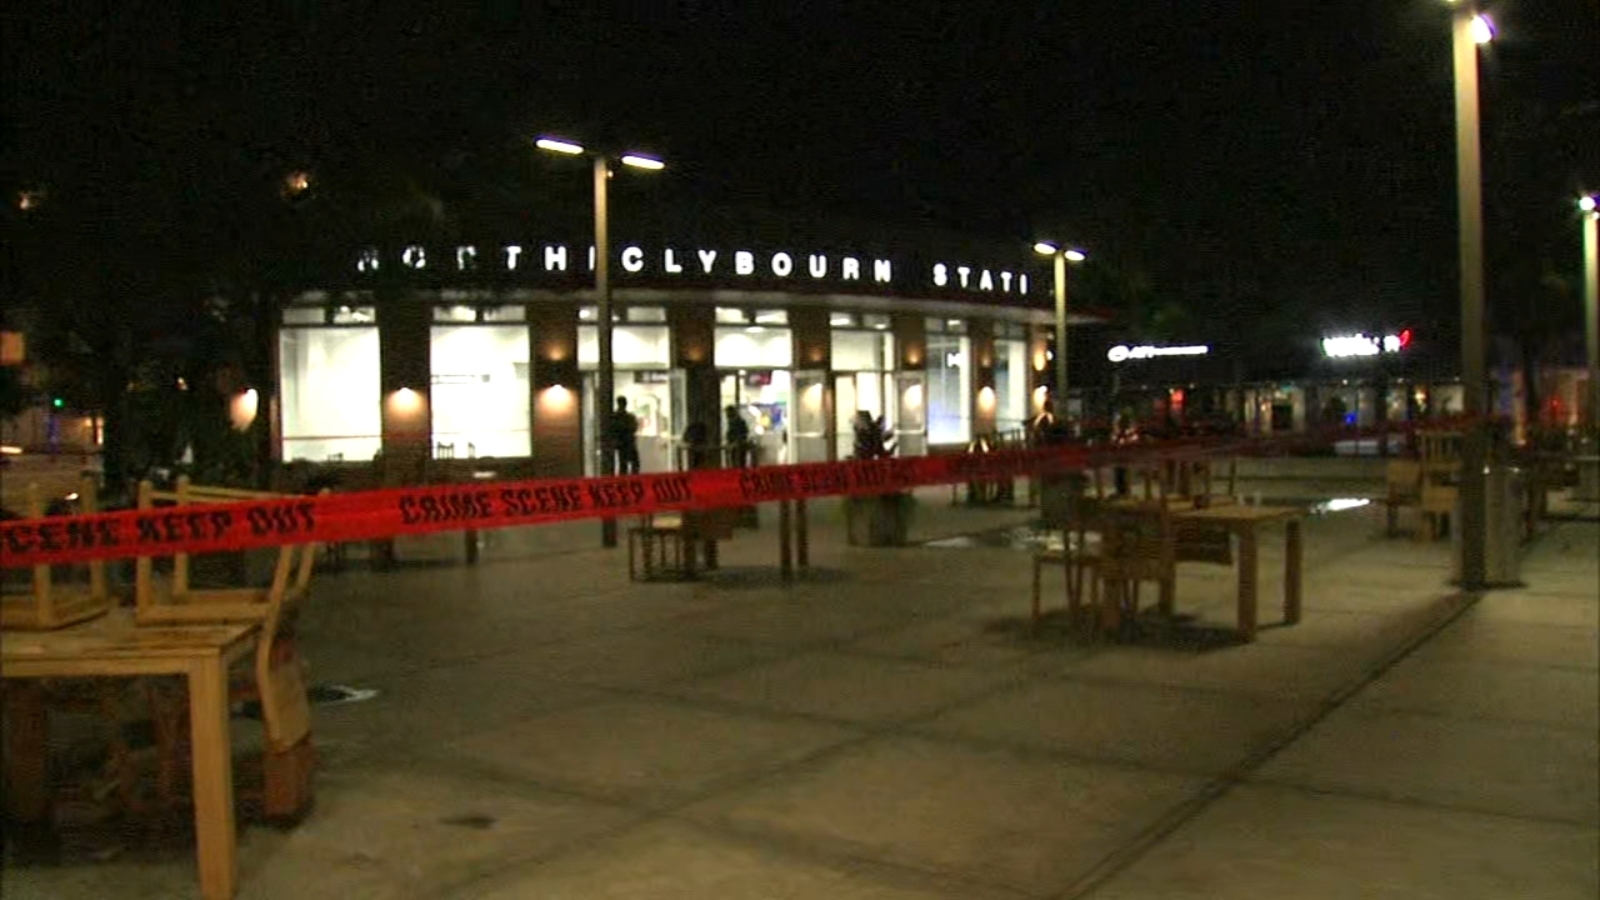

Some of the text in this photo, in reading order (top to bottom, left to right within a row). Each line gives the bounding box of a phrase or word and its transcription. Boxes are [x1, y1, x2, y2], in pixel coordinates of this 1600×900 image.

[622, 246, 893, 283] CLYBOURN
[933, 263, 1028, 295] STATI
[400, 475, 692, 525] CRIME SCENE KEEP OUT
[0, 502, 315, 553] CENE KEEP OUT
